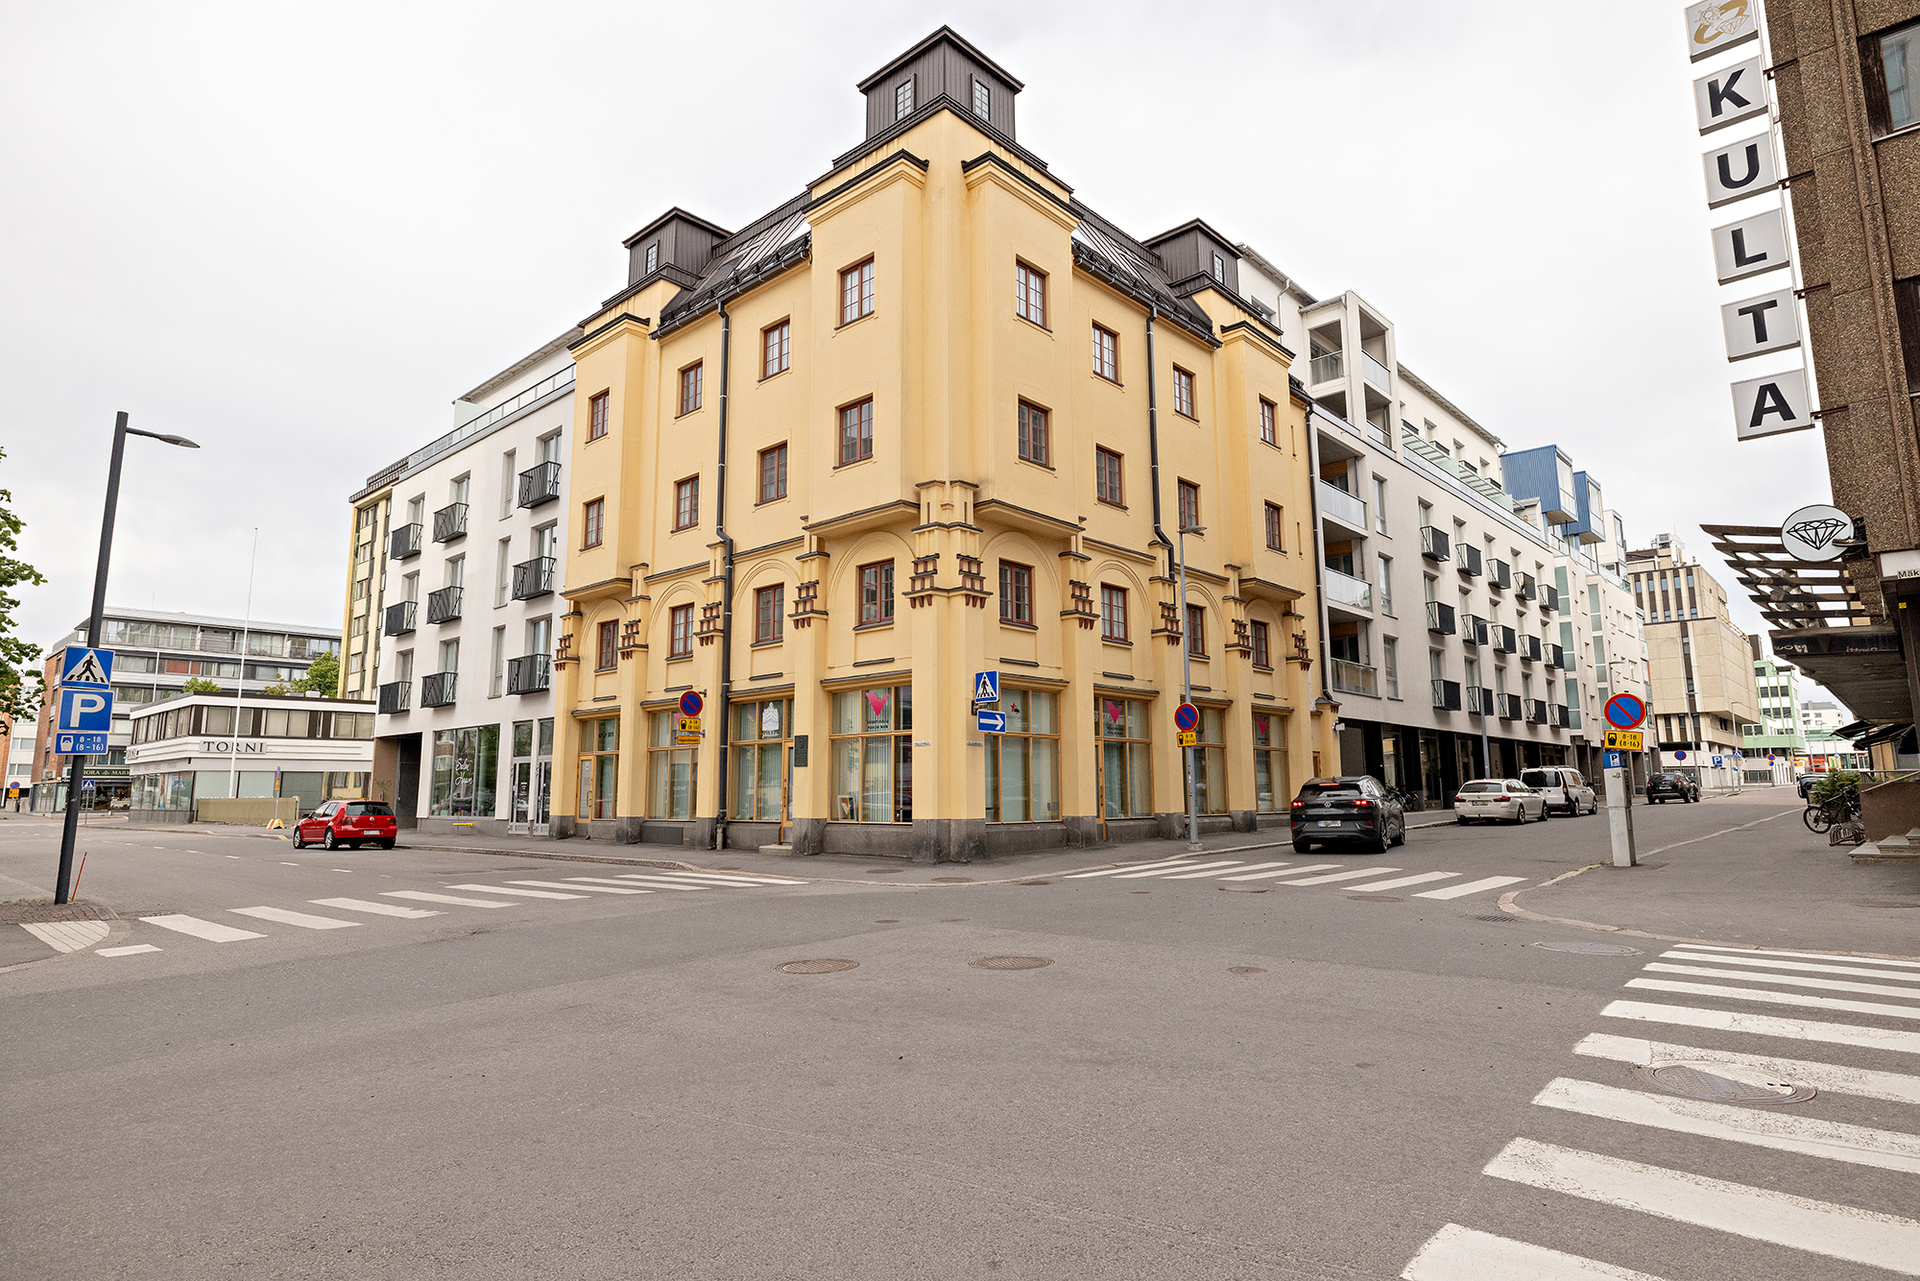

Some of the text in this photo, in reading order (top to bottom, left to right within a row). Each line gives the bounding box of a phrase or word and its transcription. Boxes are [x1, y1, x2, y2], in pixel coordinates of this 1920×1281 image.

[1707, 67, 1797, 428] KULTA
[69, 693, 106, 728] P
[203, 740, 265, 753] TORNI
[1713, 756, 1721, 765] P
